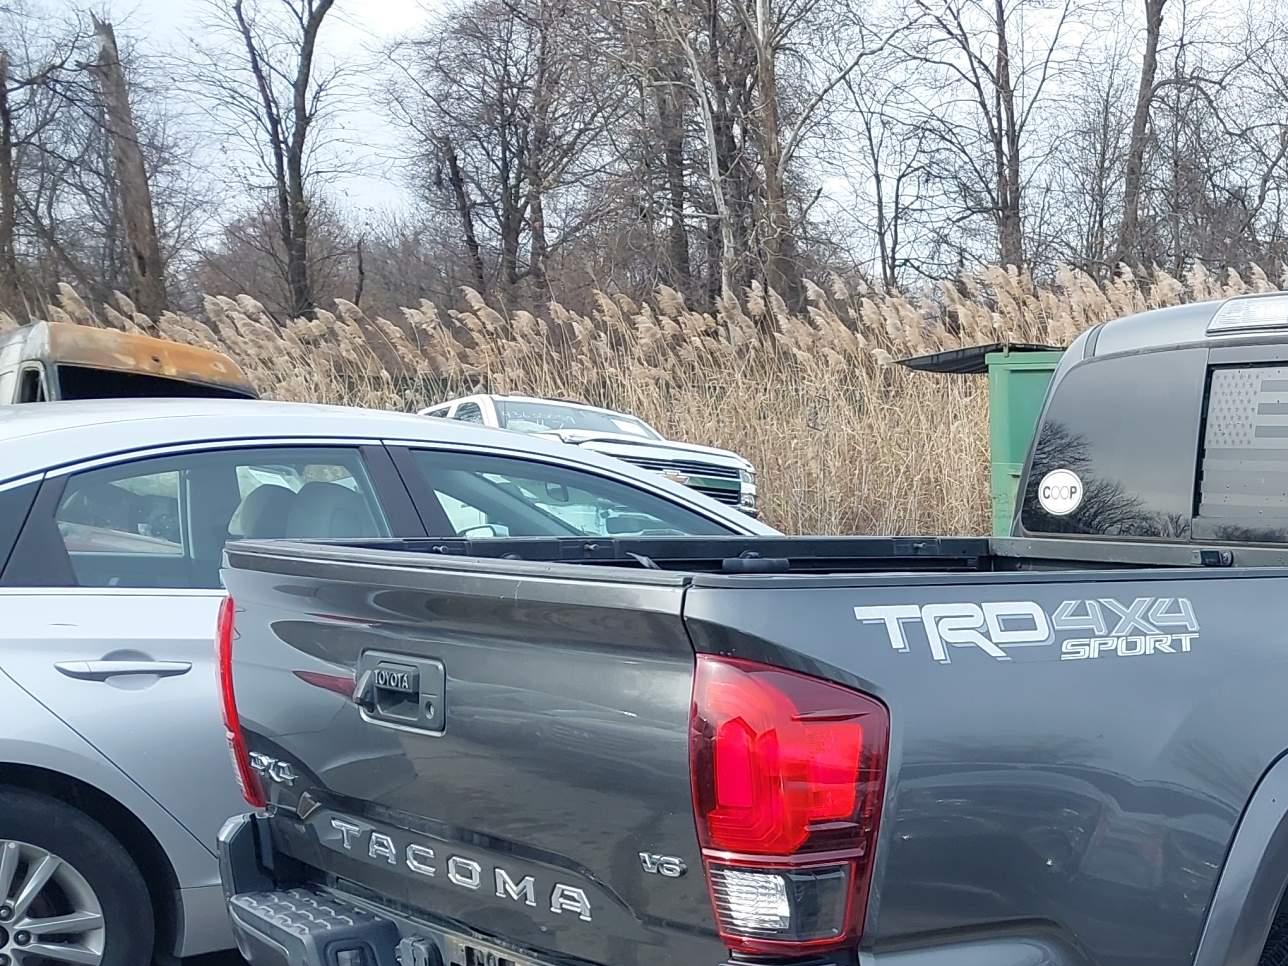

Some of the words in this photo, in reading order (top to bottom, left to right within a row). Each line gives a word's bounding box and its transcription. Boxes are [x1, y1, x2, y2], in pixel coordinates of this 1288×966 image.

[1042, 485, 1077, 500] COOP
[853, 601, 1055, 665] TRD
[1060, 632, 1201, 661] SPORT
[373, 670, 409, 689] TOYOTA
[330, 817, 593, 922] TACOMA
[638, 851, 686, 878] V6
